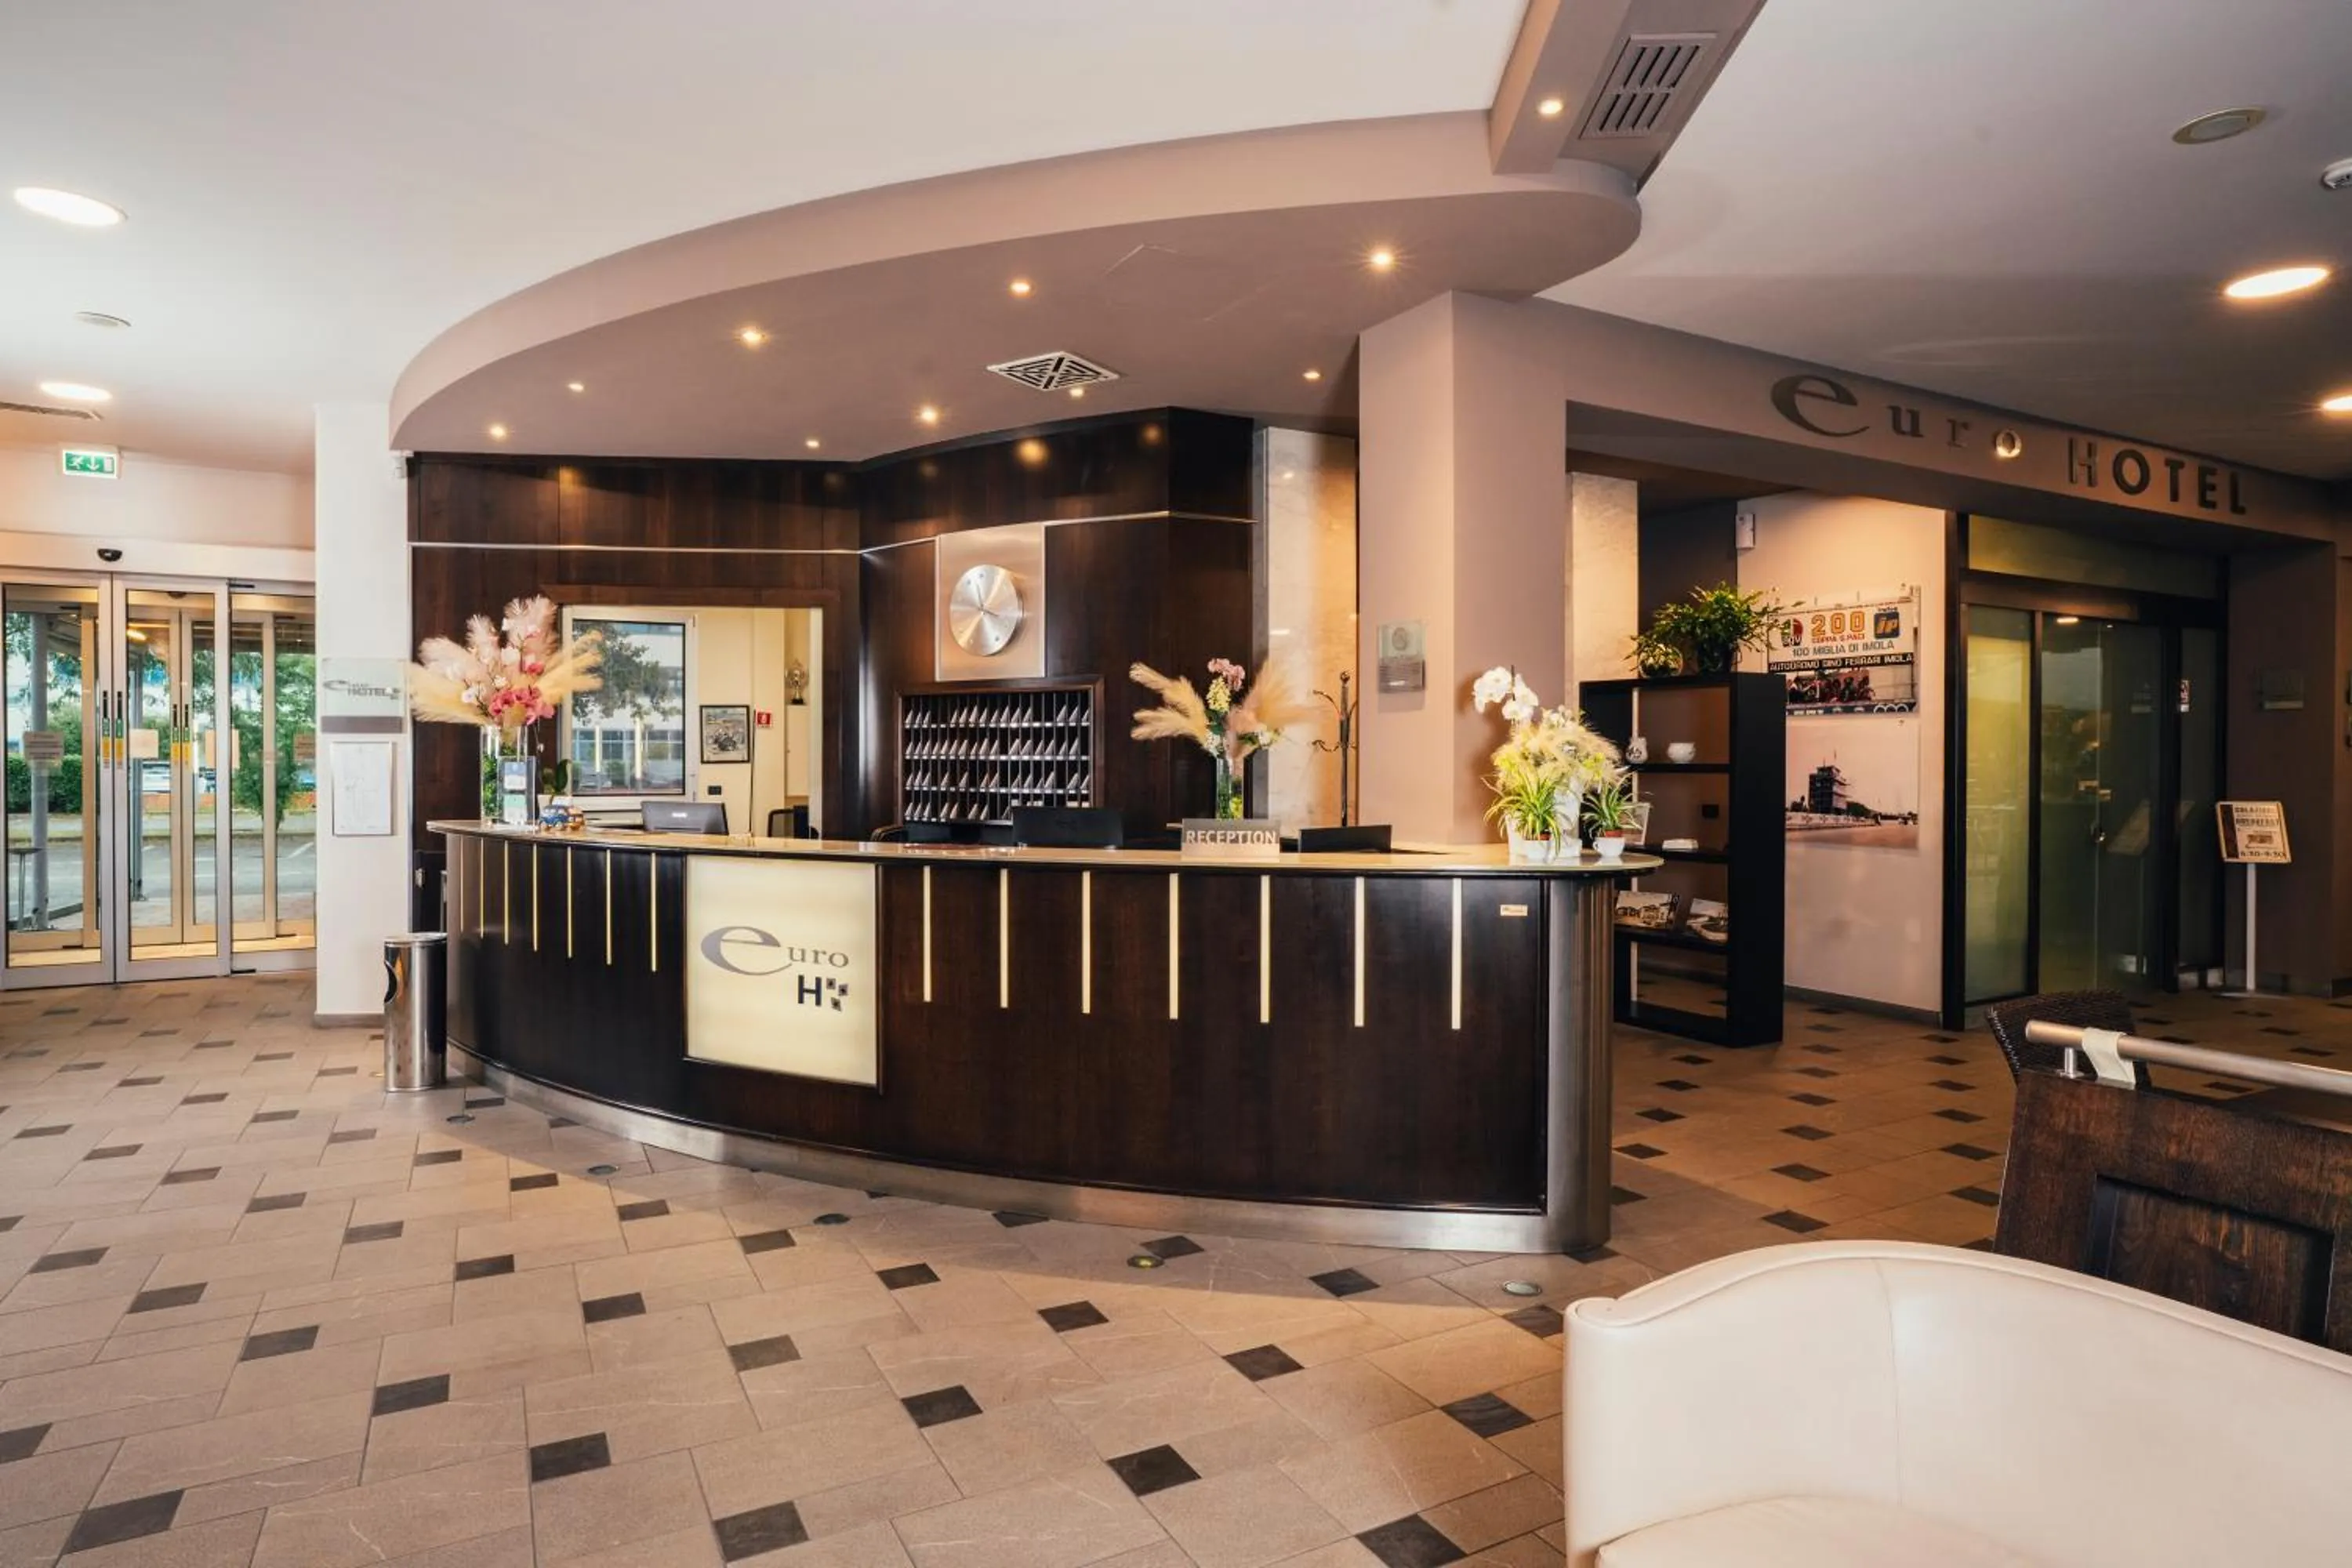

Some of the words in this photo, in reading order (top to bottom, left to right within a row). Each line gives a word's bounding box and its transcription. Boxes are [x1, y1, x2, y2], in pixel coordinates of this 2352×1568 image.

[2067, 437, 2247, 515] HOTEL
[1811, 610, 1865, 637] 200
[1792, 647, 1809, 657] 100
[1813, 644, 1846, 656] MIGLIA
[1849, 643, 1860, 652] DI
[1862, 640, 1895, 652] IMOLA
[1769, 660, 1820, 671] AUTODROMO
[1823, 659, 1842, 668] DINO
[1845, 655, 1881, 666] FERRARI
[1884, 652, 1913, 663] IMOLA
[1186, 829, 1276, 844] RECEPTION
[701, 926, 850, 976] euro
